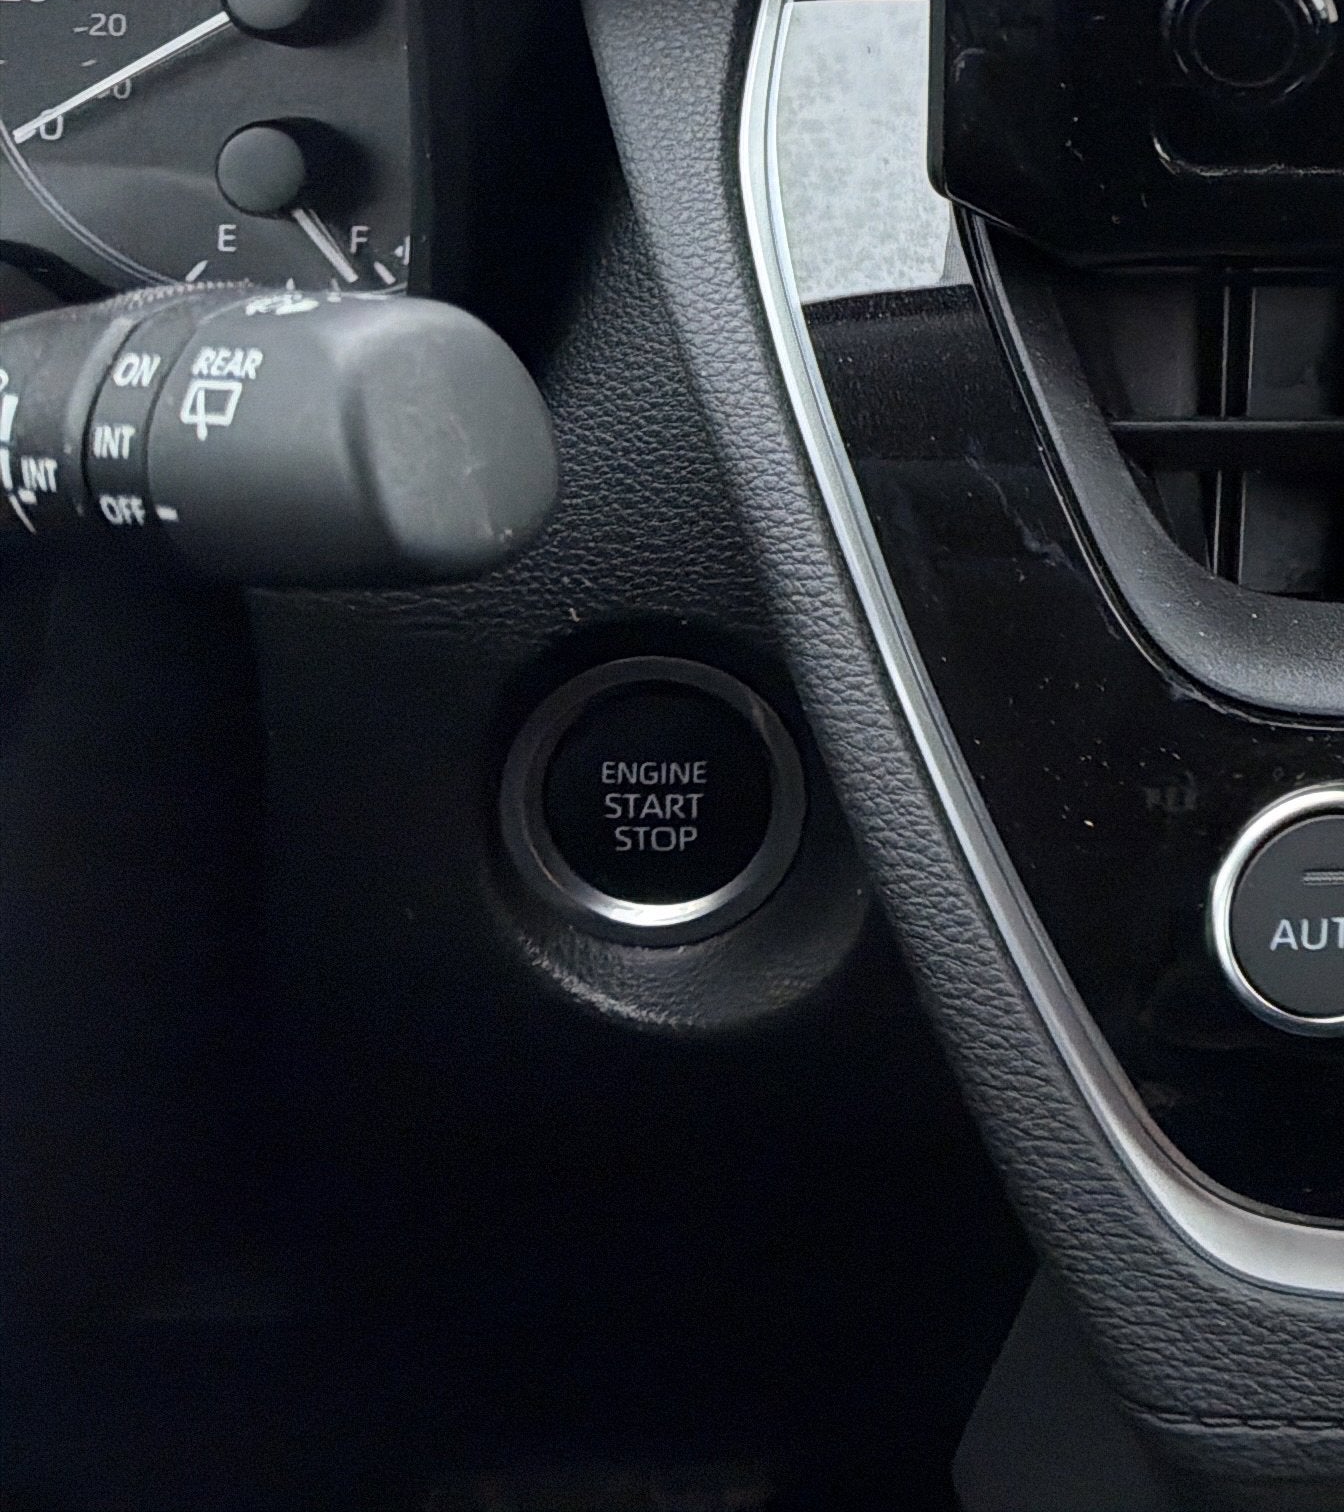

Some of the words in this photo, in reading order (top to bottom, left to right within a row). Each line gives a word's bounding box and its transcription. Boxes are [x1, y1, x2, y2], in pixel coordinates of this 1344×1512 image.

[89, 13, 126, 36] 20
[218, 224, 236, 251] E
[350, 226, 369, 253] F
[113, 353, 160, 386] ON
[193, 348, 262, 379] REAR
[94, 423, 135, 458] INT
[21, 456, 57, 492] INT
[100, 495, 145, 524] OFF
[602, 762, 706, 784] ENGINE
[606, 793, 703, 819] START
[615, 826, 697, 851] STOP
